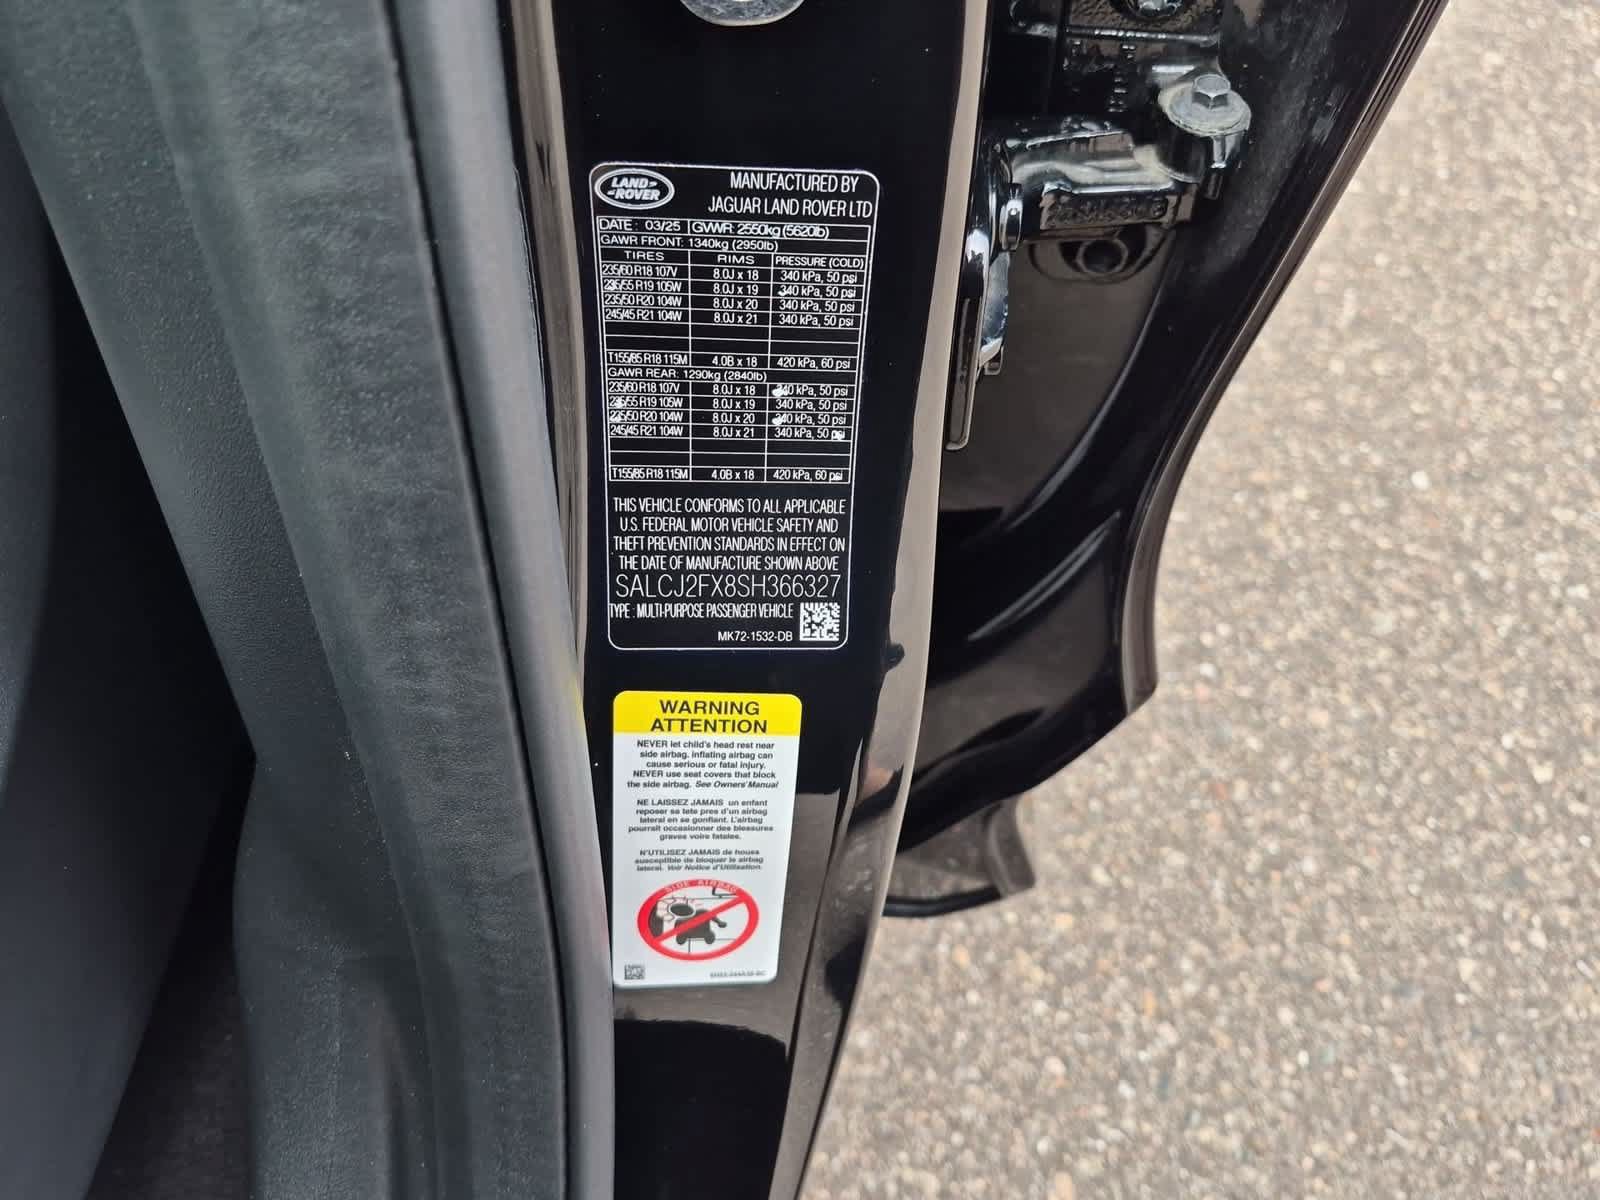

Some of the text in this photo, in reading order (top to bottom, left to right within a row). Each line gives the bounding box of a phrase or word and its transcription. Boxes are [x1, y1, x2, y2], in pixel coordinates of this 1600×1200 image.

[611, 177, 651, 189] LAND
[731, 172, 859, 192] MANUFACTURED BY
[615, 189, 660, 201] ROVER
[708, 196, 872, 217] JAGUAR LAND ROVER LTD
[645, 221, 680, 232] 03/25
[737, 223, 781, 238] 2550kg
[601, 235, 778, 252] GAWR FRONT: 1340kg (2950lb)
[624, 251, 664, 261] TIRES
[717, 255, 754, 264] RIMS
[775, 256, 864, 269] PRESSURE (COLD)
[656, 266, 678, 277] 107V
[713, 269, 759, 280] 8.0J 18
[781, 271, 857, 284] 340 kPa, 50 psi
[636, 279, 681, 292] R19 105W
[714, 283, 759, 295] 8.0J 19
[802, 286, 839, 298] kPa, 50
[636, 295, 682, 307] R20 104W
[714, 298, 758, 310] 8.0J 20
[779, 300, 838, 313] 340 kPa, 50
[637, 310, 654, 320] R21
[657, 310, 682, 321] 104W
[714, 312, 758, 324] 8.0J 21
[779, 315, 837, 327] 340 kPa, 50
[665, 354, 688, 365] 115M
[712, 356, 758, 367] 4.0B 18
[777, 358, 834, 369] 420 kPa, 60
[608, 368, 767, 382] GAWR REAR: 1290kg (2840lb)
[659, 383, 680, 394] 107V
[712, 385, 755, 395] 8.0J 18
[819, 387, 832, 397] 50
[639, 397, 683, 408] R19 105W
[712, 399, 755, 410] 8.0J 19
[775, 400, 831, 411] 340 50
[660, 411, 683, 422] 104W
[712, 414, 755, 424] 8.0J 20
[817, 415, 831, 425] 50
[610, 425, 683, 437] 245/45 R21 104W
[713, 428, 754, 438] 8.0J 21
[775, 428, 829, 439] 340 50
[666, 469, 688, 480] 115M
[711, 469, 754, 480] 4.0B 18
[773, 470, 828, 480] 420 60
[613, 498, 846, 514] THIS VEHICLE CONFORMS TO ALL APPLICABLE
[620, 517, 838, 533] U.S. FEDERAL MOTOR VEHICLE SAFETY AND
[614, 536, 845, 552] THEFT PREVENTION STANDARDS IN EFFECT ON
[619, 555, 839, 571] THE DATE OF MANUFACTURE SHOWN ABOVE
[615, 573, 841, 598] SALCJ2FX8SH366327
[637, 603, 705, 618] MULTI-PURPOSE
[706, 603, 757, 618] PASSENGER
[759, 603, 793, 618] VEHICLE
[718, 631, 793, 642] MK72-1532-DB
[659, 699, 760, 715] WARNING
[651, 718, 767, 733] ATTENTION
[637, 740, 668, 748] NEVER
[670, 740, 680, 748] let
[683, 741, 711, 749] child's
[713, 741, 734, 749] head
[660, 751, 690, 760] airbag.
[729, 752, 755, 761] airbag
[719, 761, 738, 769] fatal
[740, 761, 766, 770] injury.
[633, 770, 663, 778] NEVER
[684, 771, 701, 779] seat
[734, 771, 751, 779] that
[753, 771, 776, 779] block
[663, 782, 690, 790] airbag.
[748, 781, 779, 789] Manual
[690, 799, 724, 807] JAMAIS
